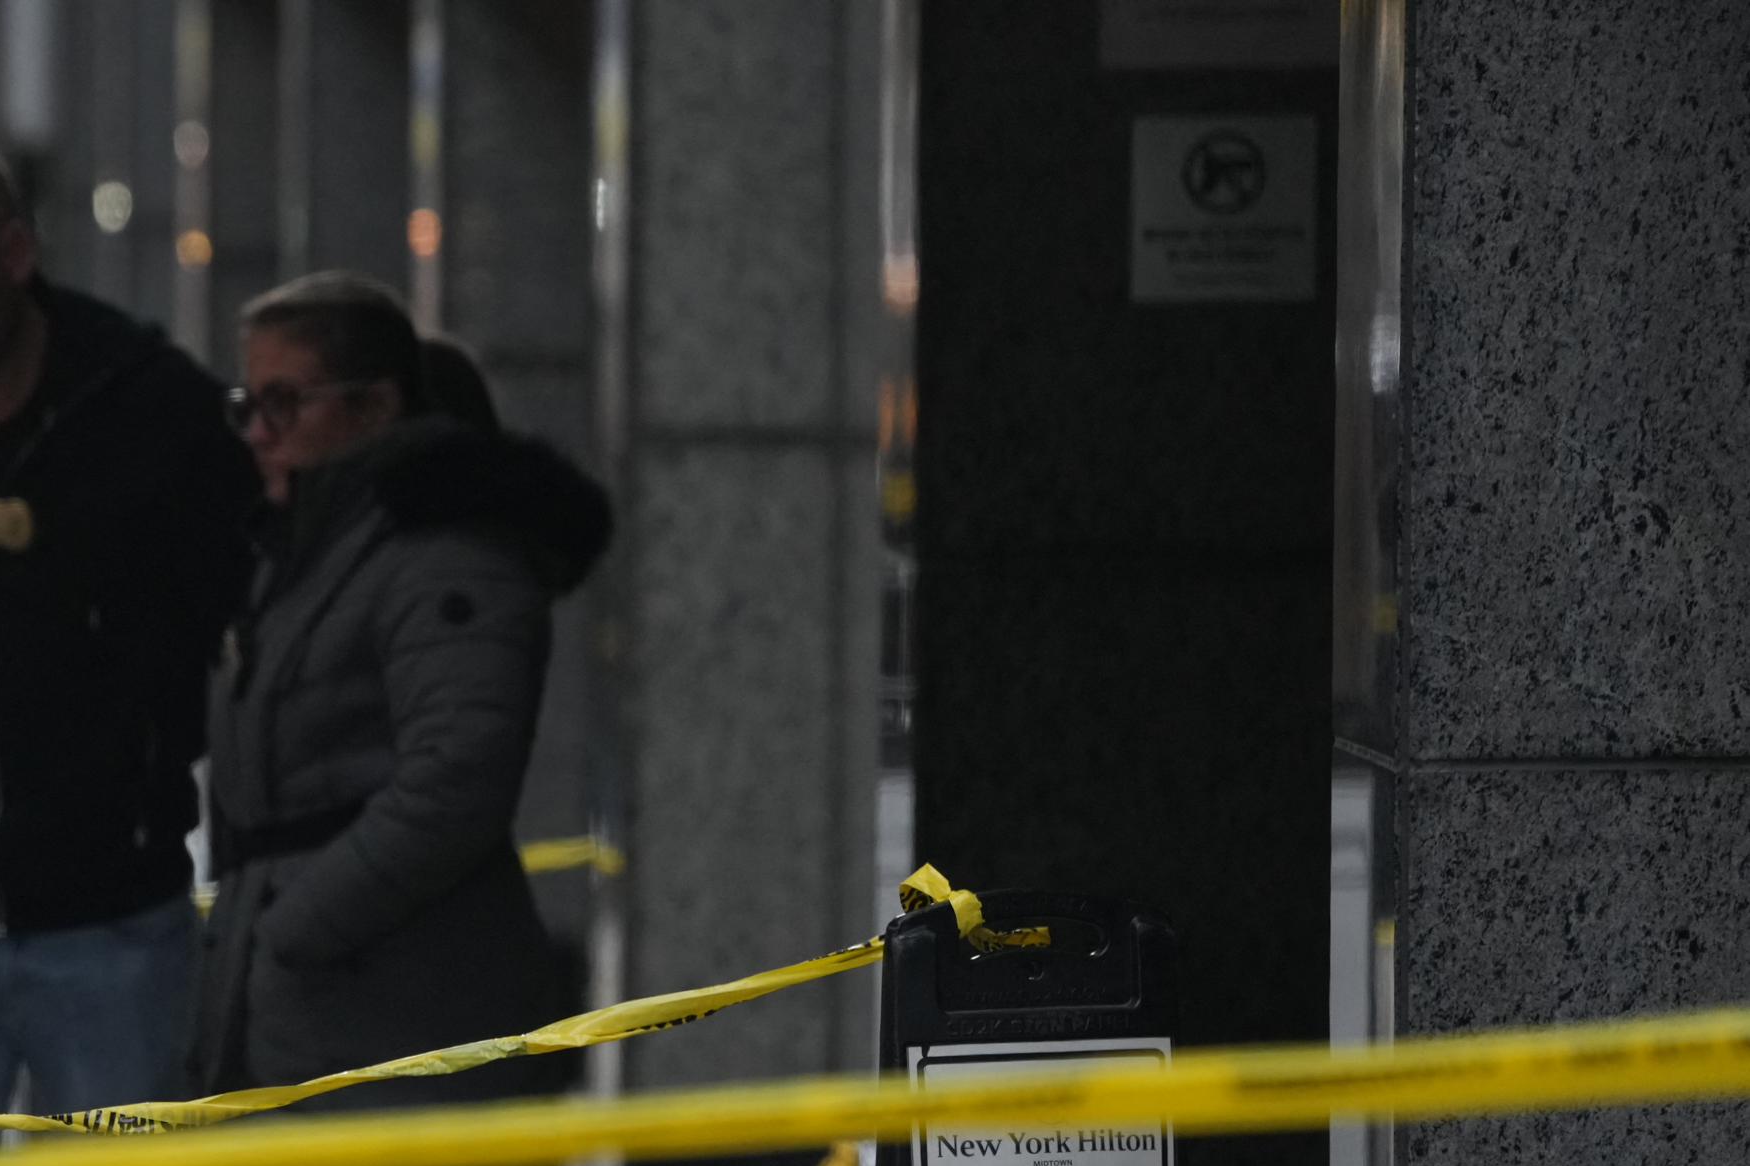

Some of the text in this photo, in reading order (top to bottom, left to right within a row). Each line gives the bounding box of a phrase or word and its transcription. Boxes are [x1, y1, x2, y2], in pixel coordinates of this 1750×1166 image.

[937, 1128, 1156, 1158] New York Hilton
